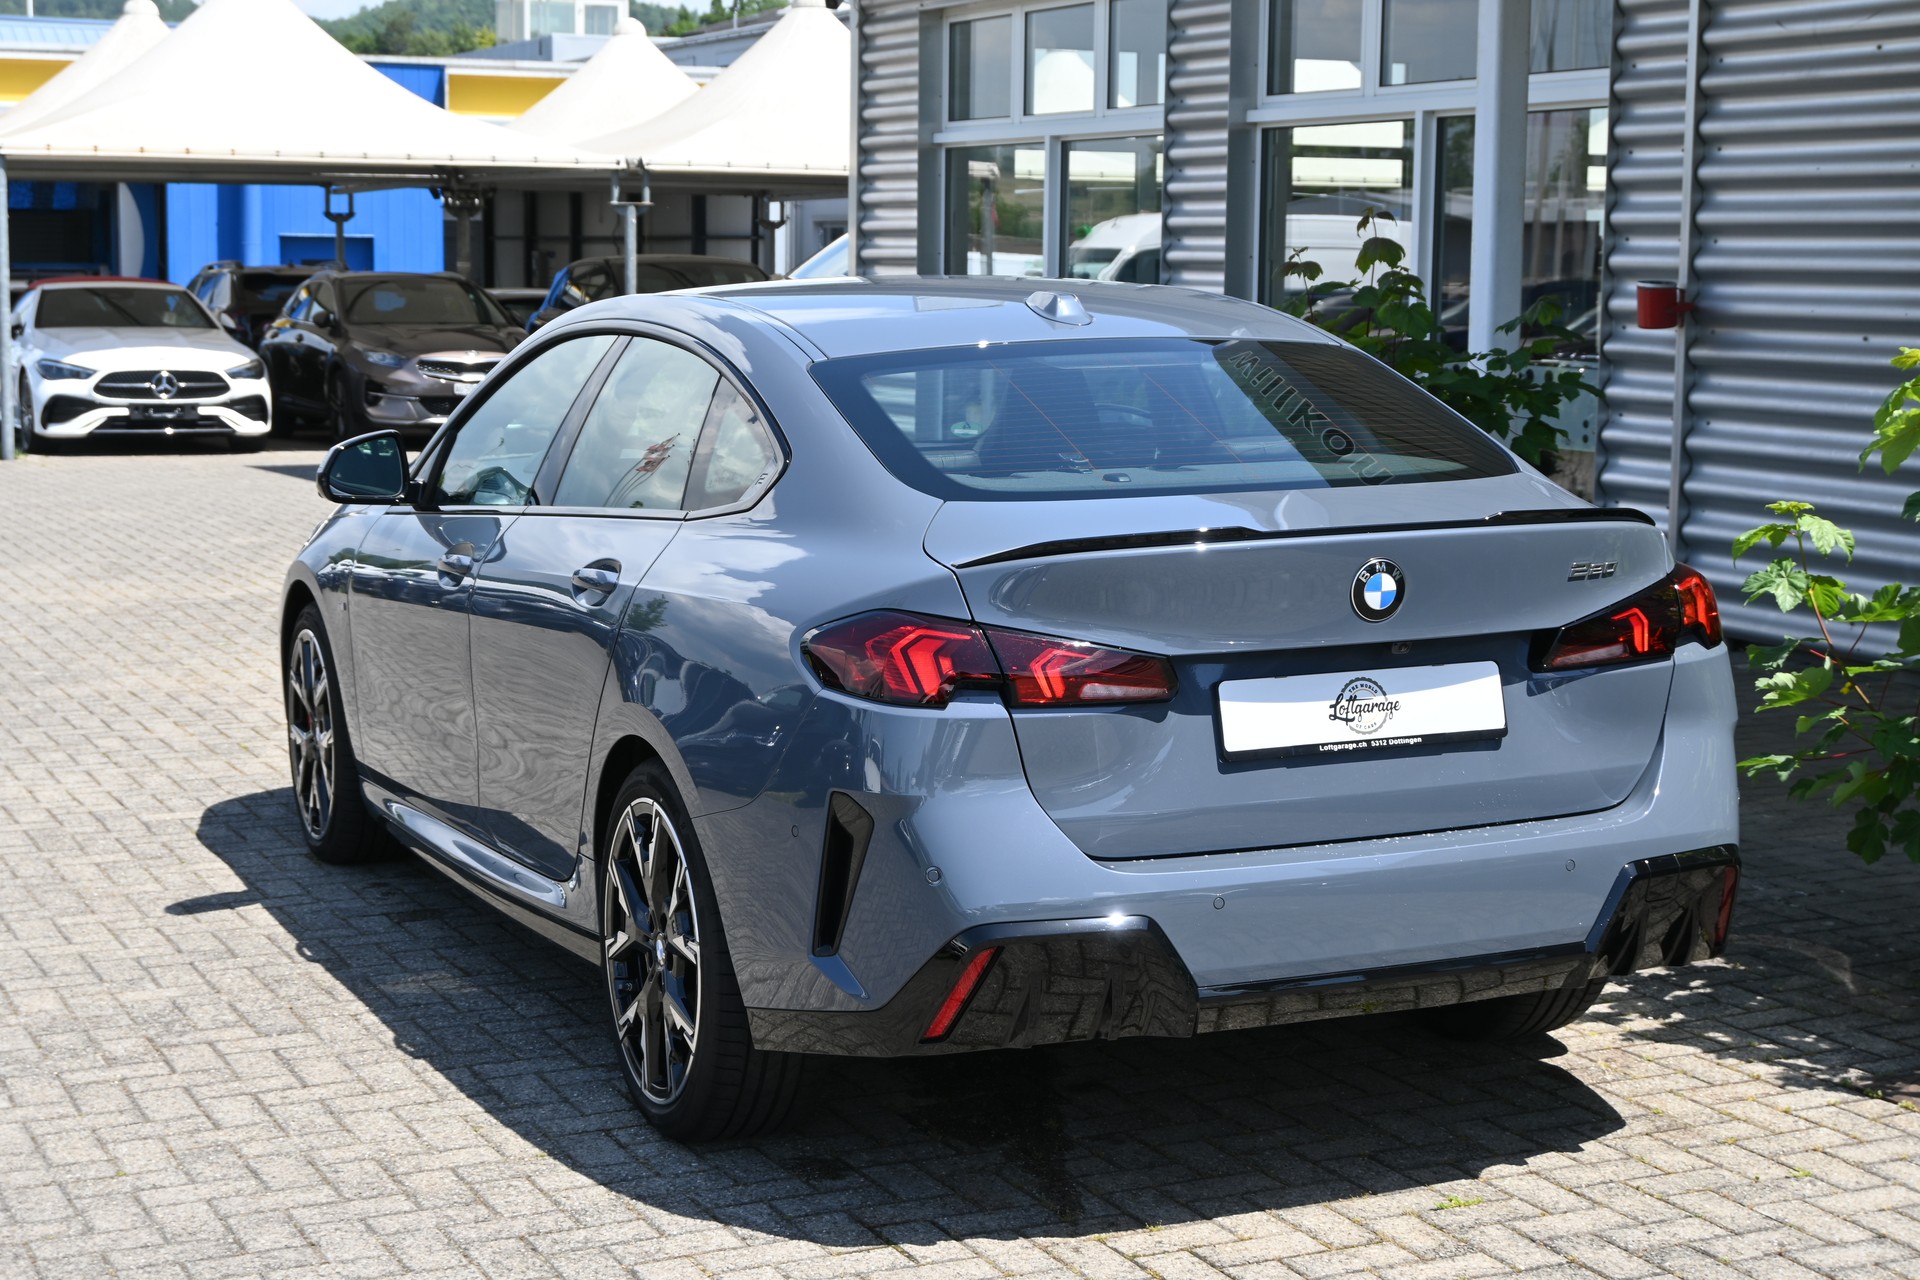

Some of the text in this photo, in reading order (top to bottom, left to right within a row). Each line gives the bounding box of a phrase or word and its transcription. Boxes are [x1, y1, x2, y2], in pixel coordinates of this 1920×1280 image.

[1359, 562, 1402, 583] BMW
[1348, 683, 1378, 693] THE WORLD
[1329, 693, 1401, 726] Loftgarage
[1319, 741, 1368, 751] Loftgarage.ch
